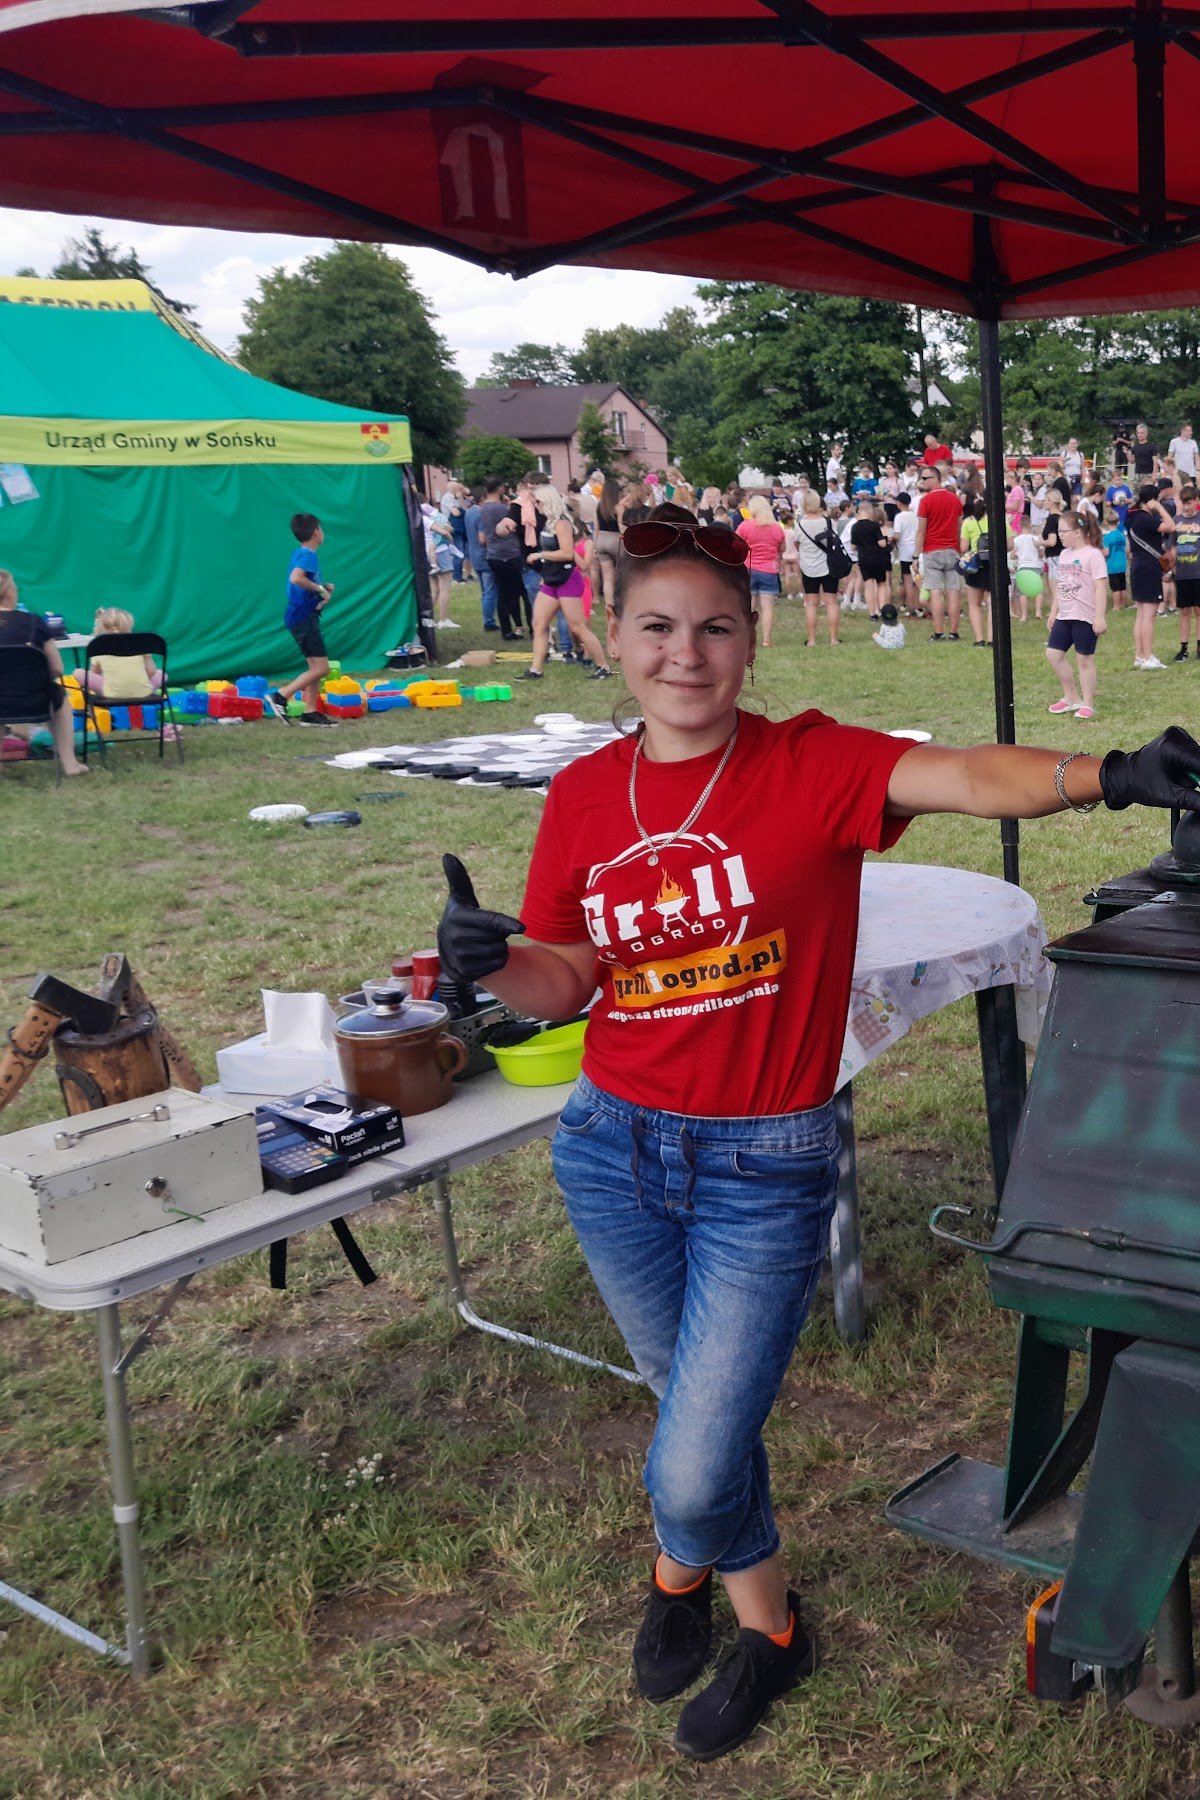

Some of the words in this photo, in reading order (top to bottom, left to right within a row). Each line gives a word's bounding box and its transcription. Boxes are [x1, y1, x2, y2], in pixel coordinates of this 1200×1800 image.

[46, 432, 106, 453] Urząd
[113, 432, 178, 453] Gminy
[184, 435, 200, 448] w
[206, 431, 277, 448] Sońsku
[630, 917, 726, 953] OGRÓD
[691, 982, 780, 1016] grillowania
